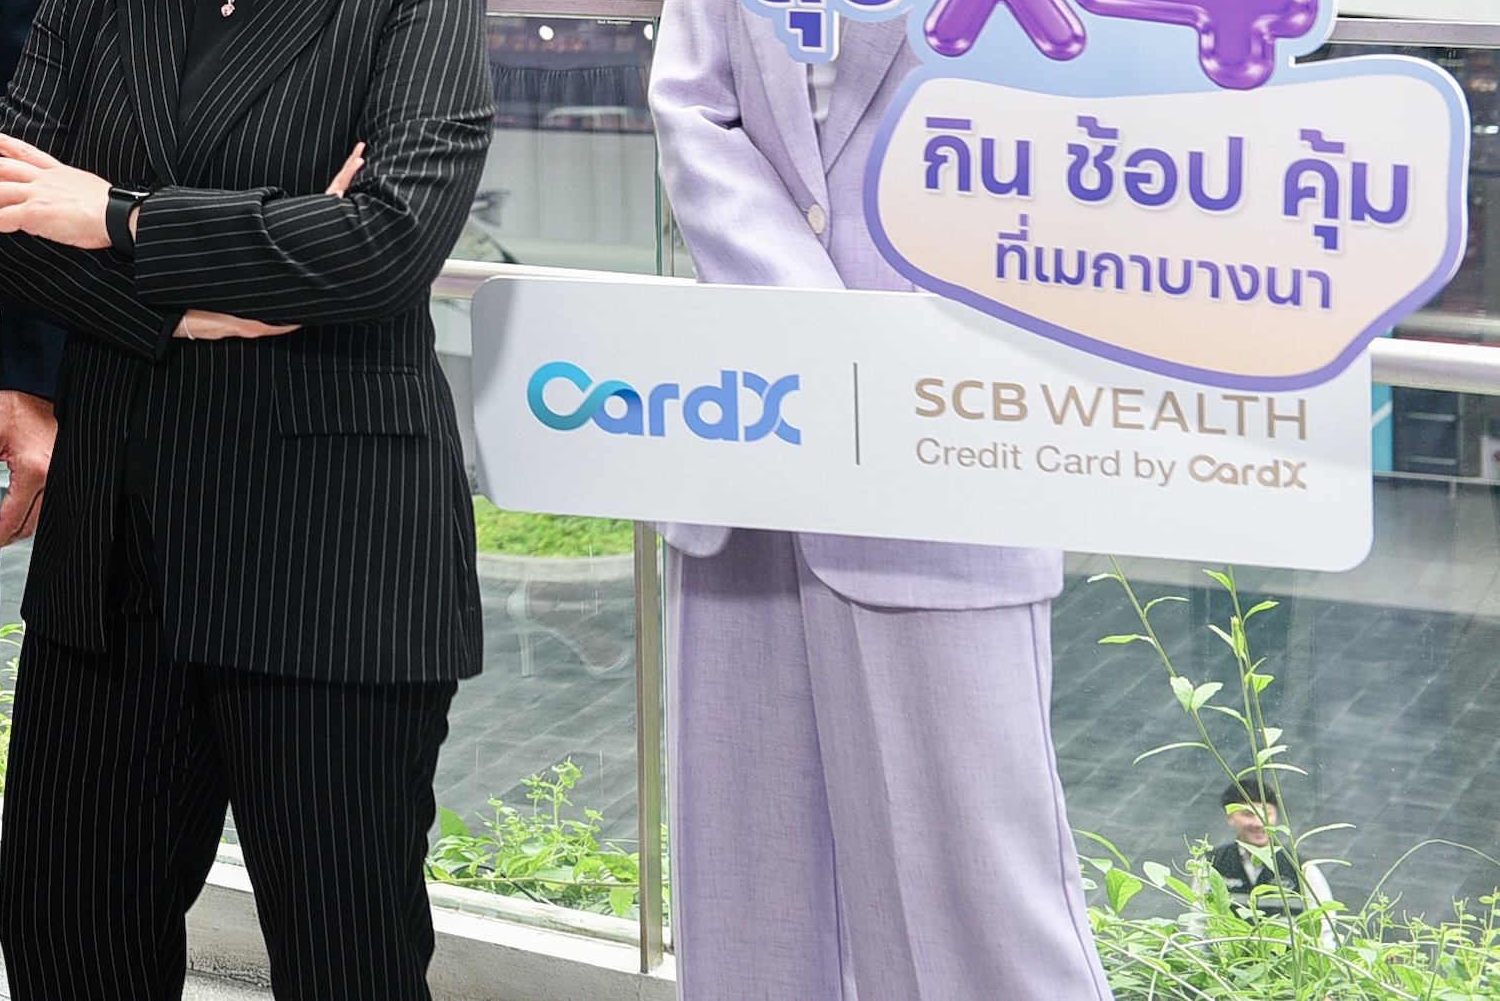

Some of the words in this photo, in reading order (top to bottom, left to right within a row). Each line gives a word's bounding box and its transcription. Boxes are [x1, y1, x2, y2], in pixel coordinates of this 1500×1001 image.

[923, 116, 1031, 197] กิน
[1066, 115, 1243, 211] ช้อป
[1282, 129, 1410, 250] คุ้ม
[995, 214, 1332, 309] ที่เมกาบางนา
[526, 361, 801, 446] CardX
[914, 378, 1028, 422] SCB
[1040, 383, 1308, 440] WEALTH
[915, 437, 1022, 471] Credit
[1036, 444, 1121, 477] Card
[1133, 451, 1176, 487] by
[1188, 454, 1308, 490] CardX
